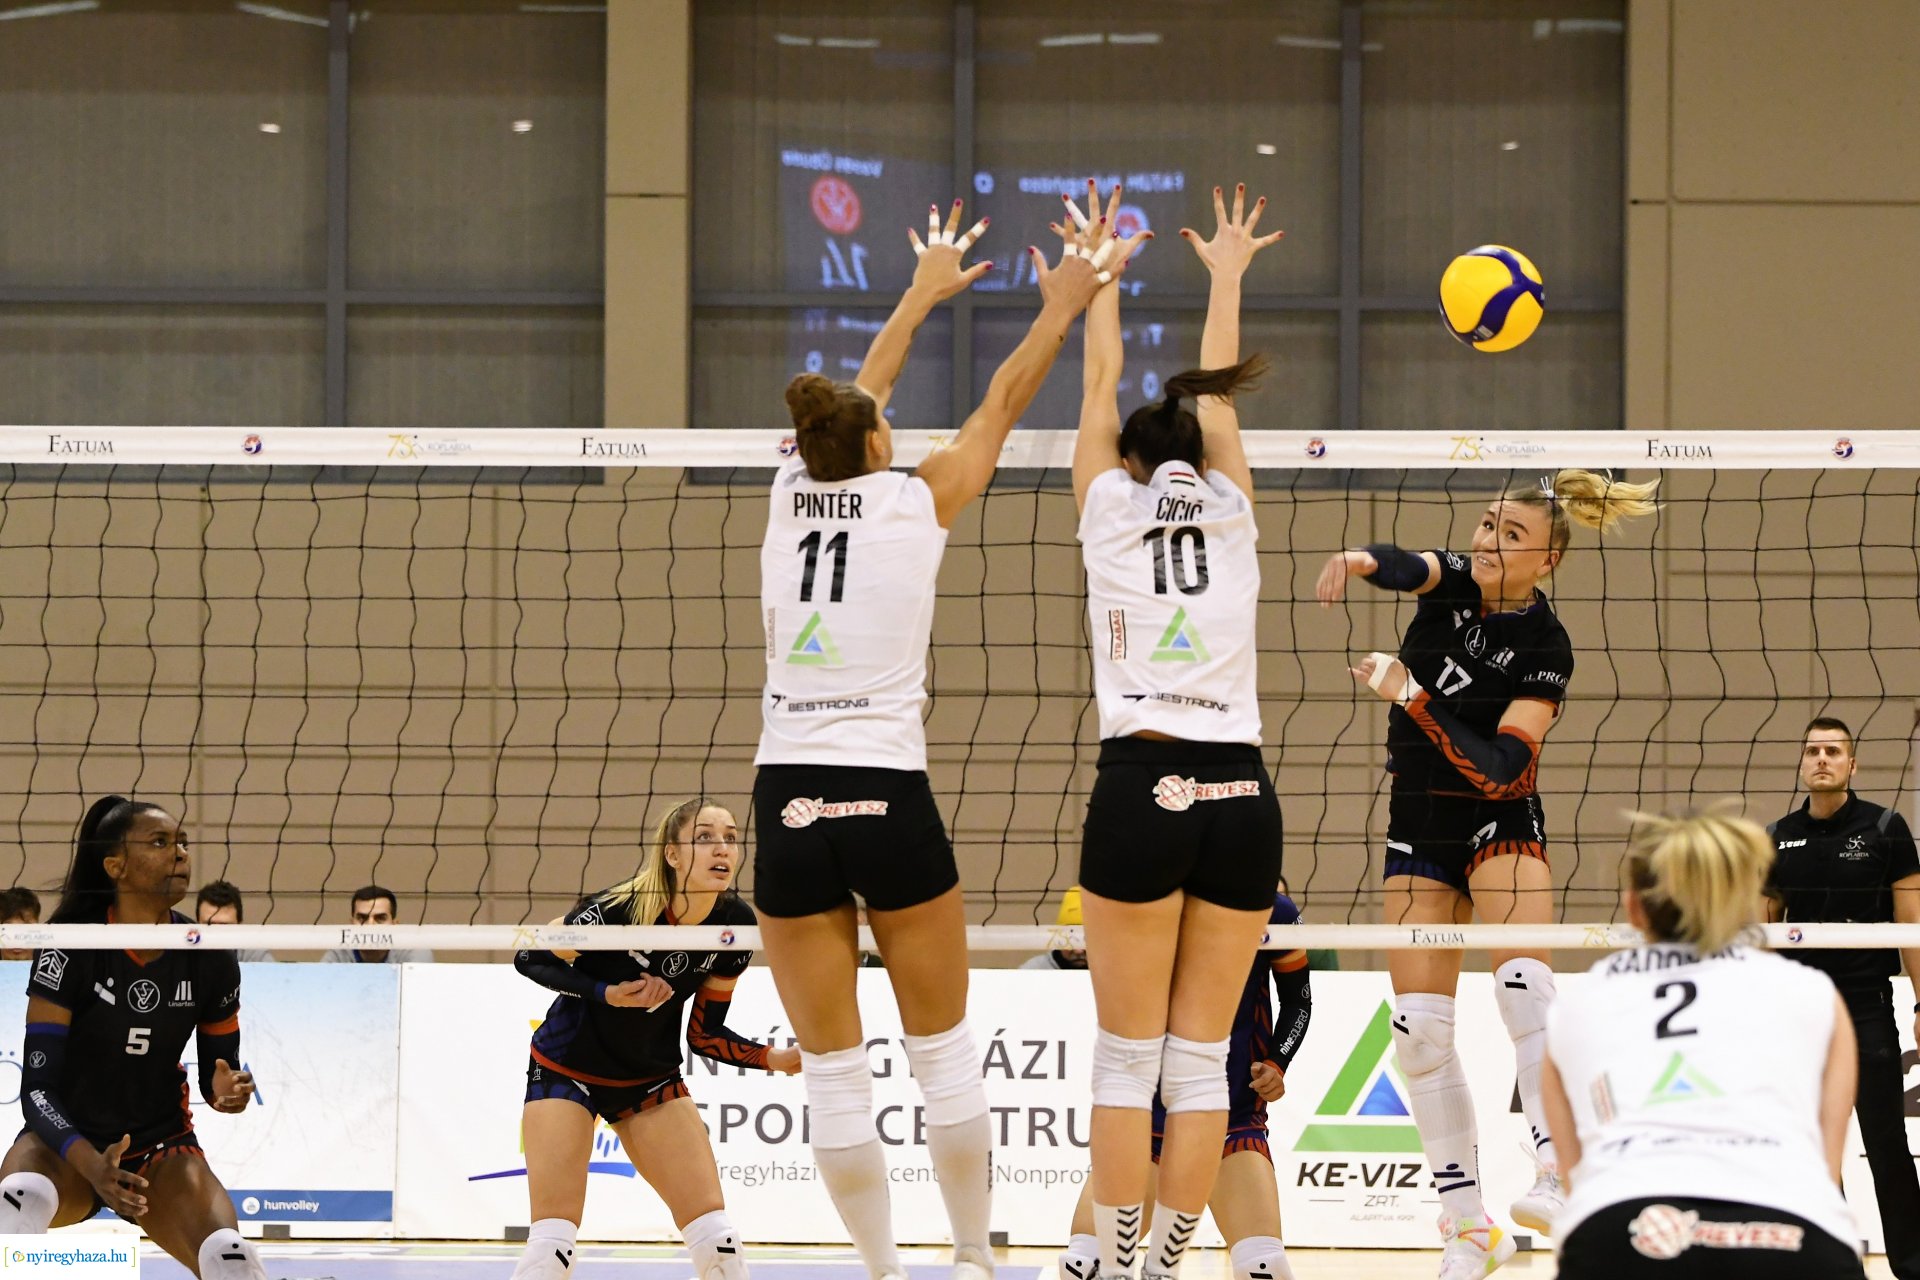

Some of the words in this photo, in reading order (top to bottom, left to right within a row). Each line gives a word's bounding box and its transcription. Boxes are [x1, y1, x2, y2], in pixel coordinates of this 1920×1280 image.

[794, 489, 862, 519] PINTÉR
[797, 531, 849, 602] 11
[1143, 526, 1210, 595] 10
[1435, 655, 1473, 696] 17
[788, 698, 869, 712] BESTRONG
[1654, 981, 1699, 1040] 2
[125, 1027, 151, 1055] 5
[264, 1200, 319, 1214] hunvolley
